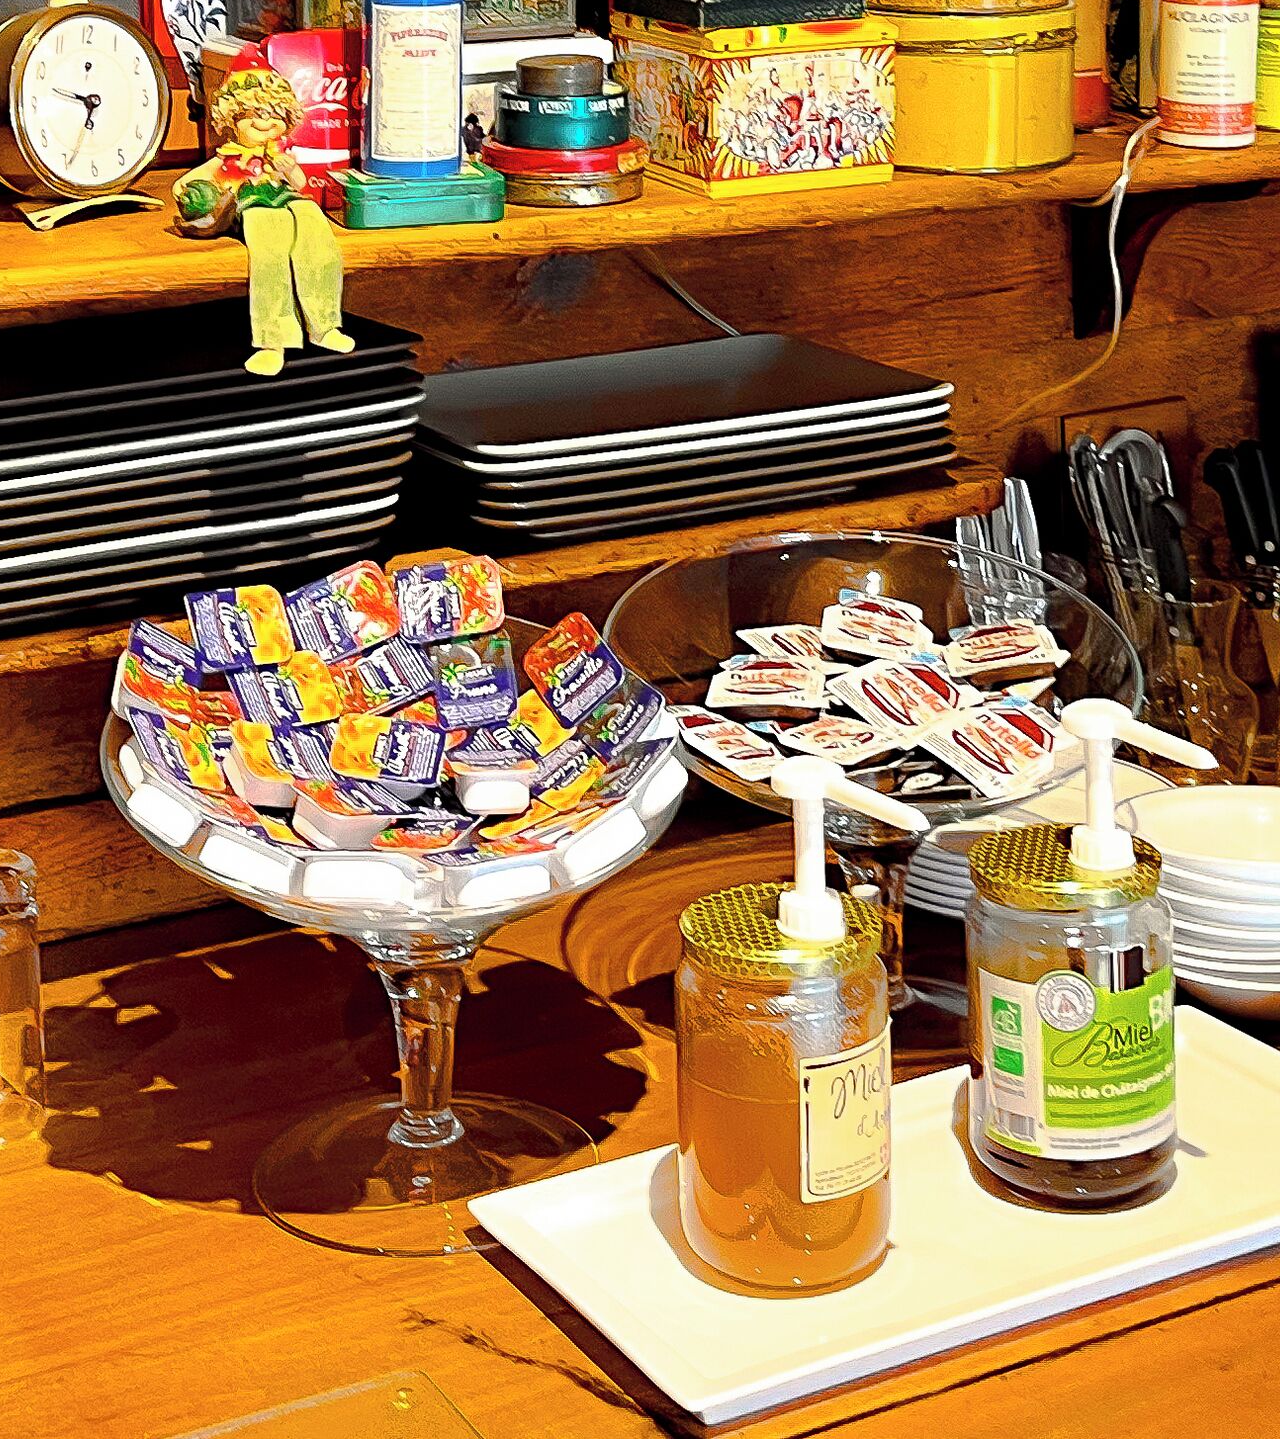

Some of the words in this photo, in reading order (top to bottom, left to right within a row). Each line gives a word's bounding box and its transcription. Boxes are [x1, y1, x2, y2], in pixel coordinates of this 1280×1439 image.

[81, 24, 94, 45] 12
[117, 148, 126, 167] 5
[885, 666, 946, 713] nutella
[975, 713, 1042, 760] nutella
[1113, 1019, 1154, 1050] Miel
[1081, 1084, 1100, 1099] de
